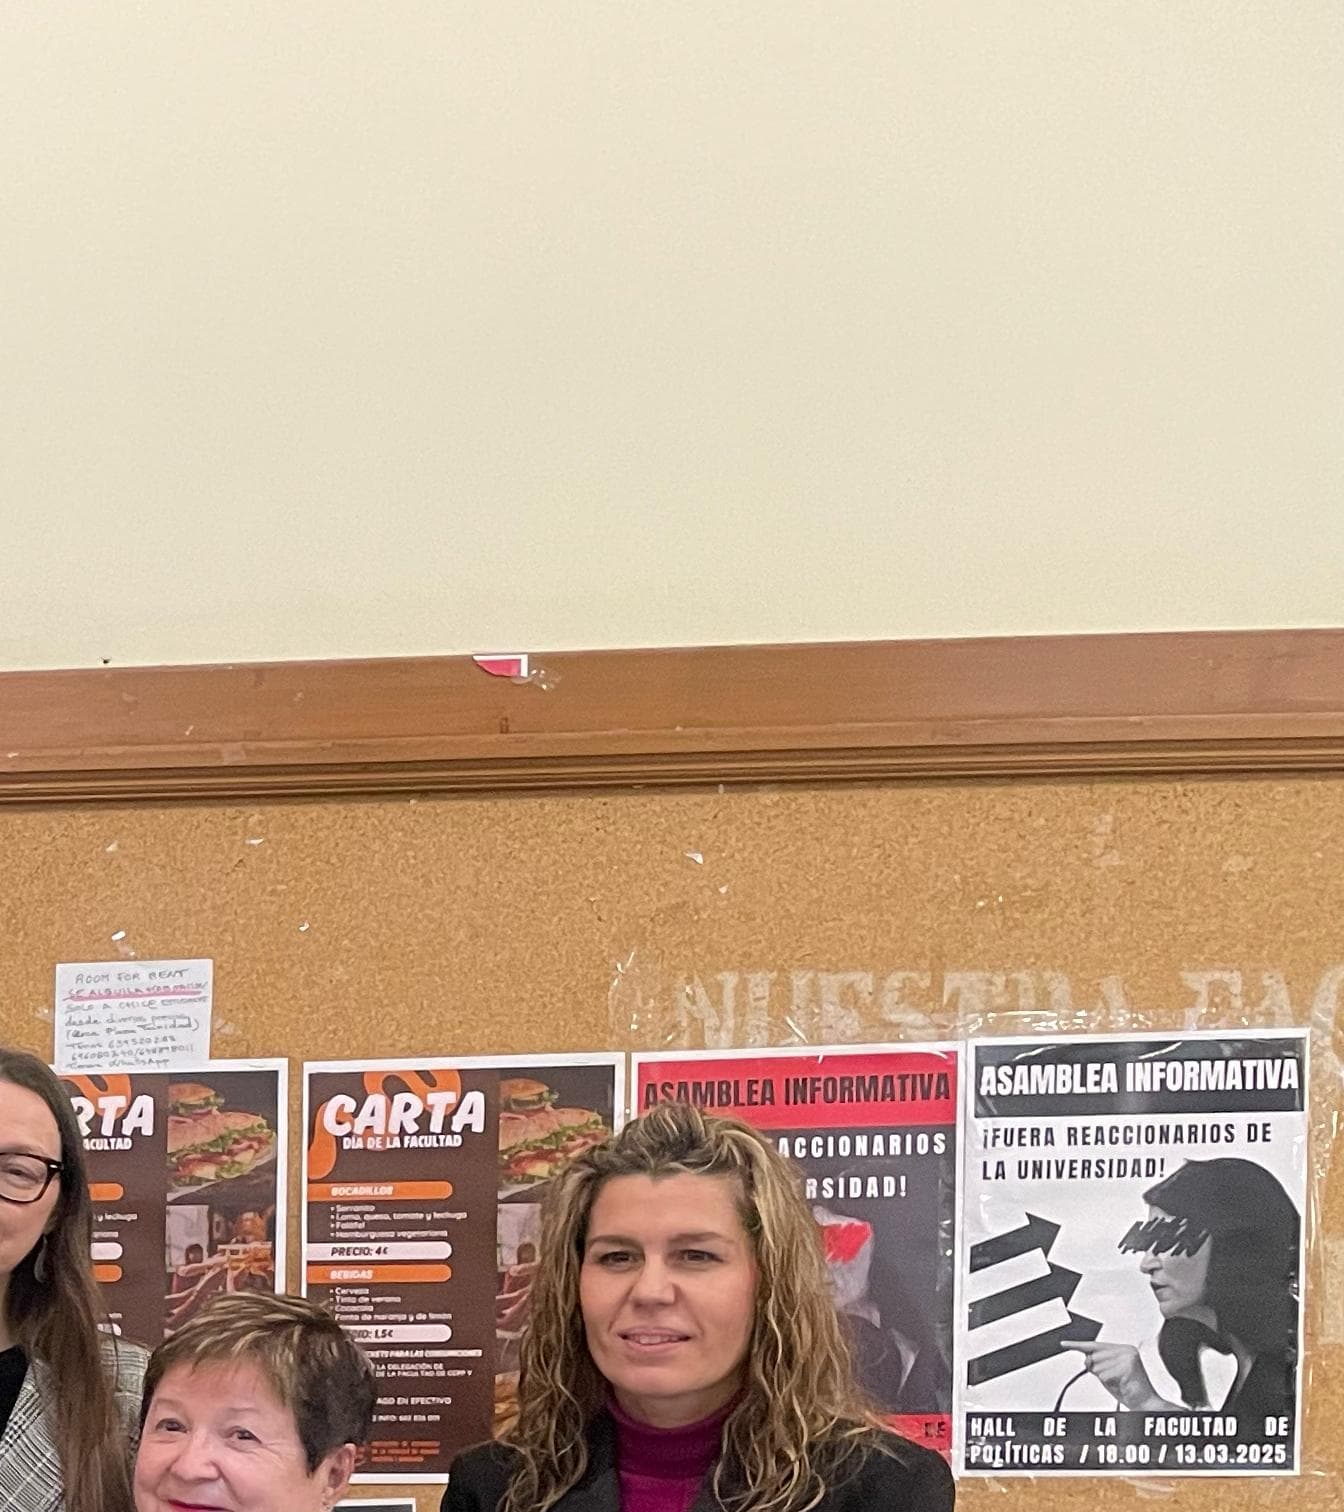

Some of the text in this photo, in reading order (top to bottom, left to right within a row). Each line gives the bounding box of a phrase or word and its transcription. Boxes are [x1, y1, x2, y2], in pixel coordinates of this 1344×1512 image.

[979, 1058, 1298, 1096] ASAMBLEA INFORMATIVA
[785, 1073, 949, 1106] INFORMATIVA
[71, 1095, 154, 1137] RTA
[324, 1091, 485, 1136] CARTA
[83, 1138, 132, 1150] ACULTAD
[342, 1134, 462, 1149] DÍA DE LA FACULTAD
[778, 1133, 946, 1158] ACCIONARIOS
[982, 1123, 1272, 1150] ¡FUERA REACCIONARIOS DE
[982, 1158, 1165, 1181] LA UNIVERSIDAD!
[331, 1186, 393, 1196] BOCADILLOS
[433, 1212, 467, 1220] lechuga
[331, 1247, 373, 1256] PRECIO:
[330, 1270, 373, 1279] BEBIDAS
[410, 1397, 452, 1405] EFECTIVO
[971, 1417, 1289, 1437] HALL DE LA FACULTAD DE
[970, 1441, 1064, 1465] POLÍTICAS
[1080, 1444, 1089, 1464] /
[1158, 1444, 1167, 1464] /
[1175, 1444, 1286, 1464] 13.03.2025
